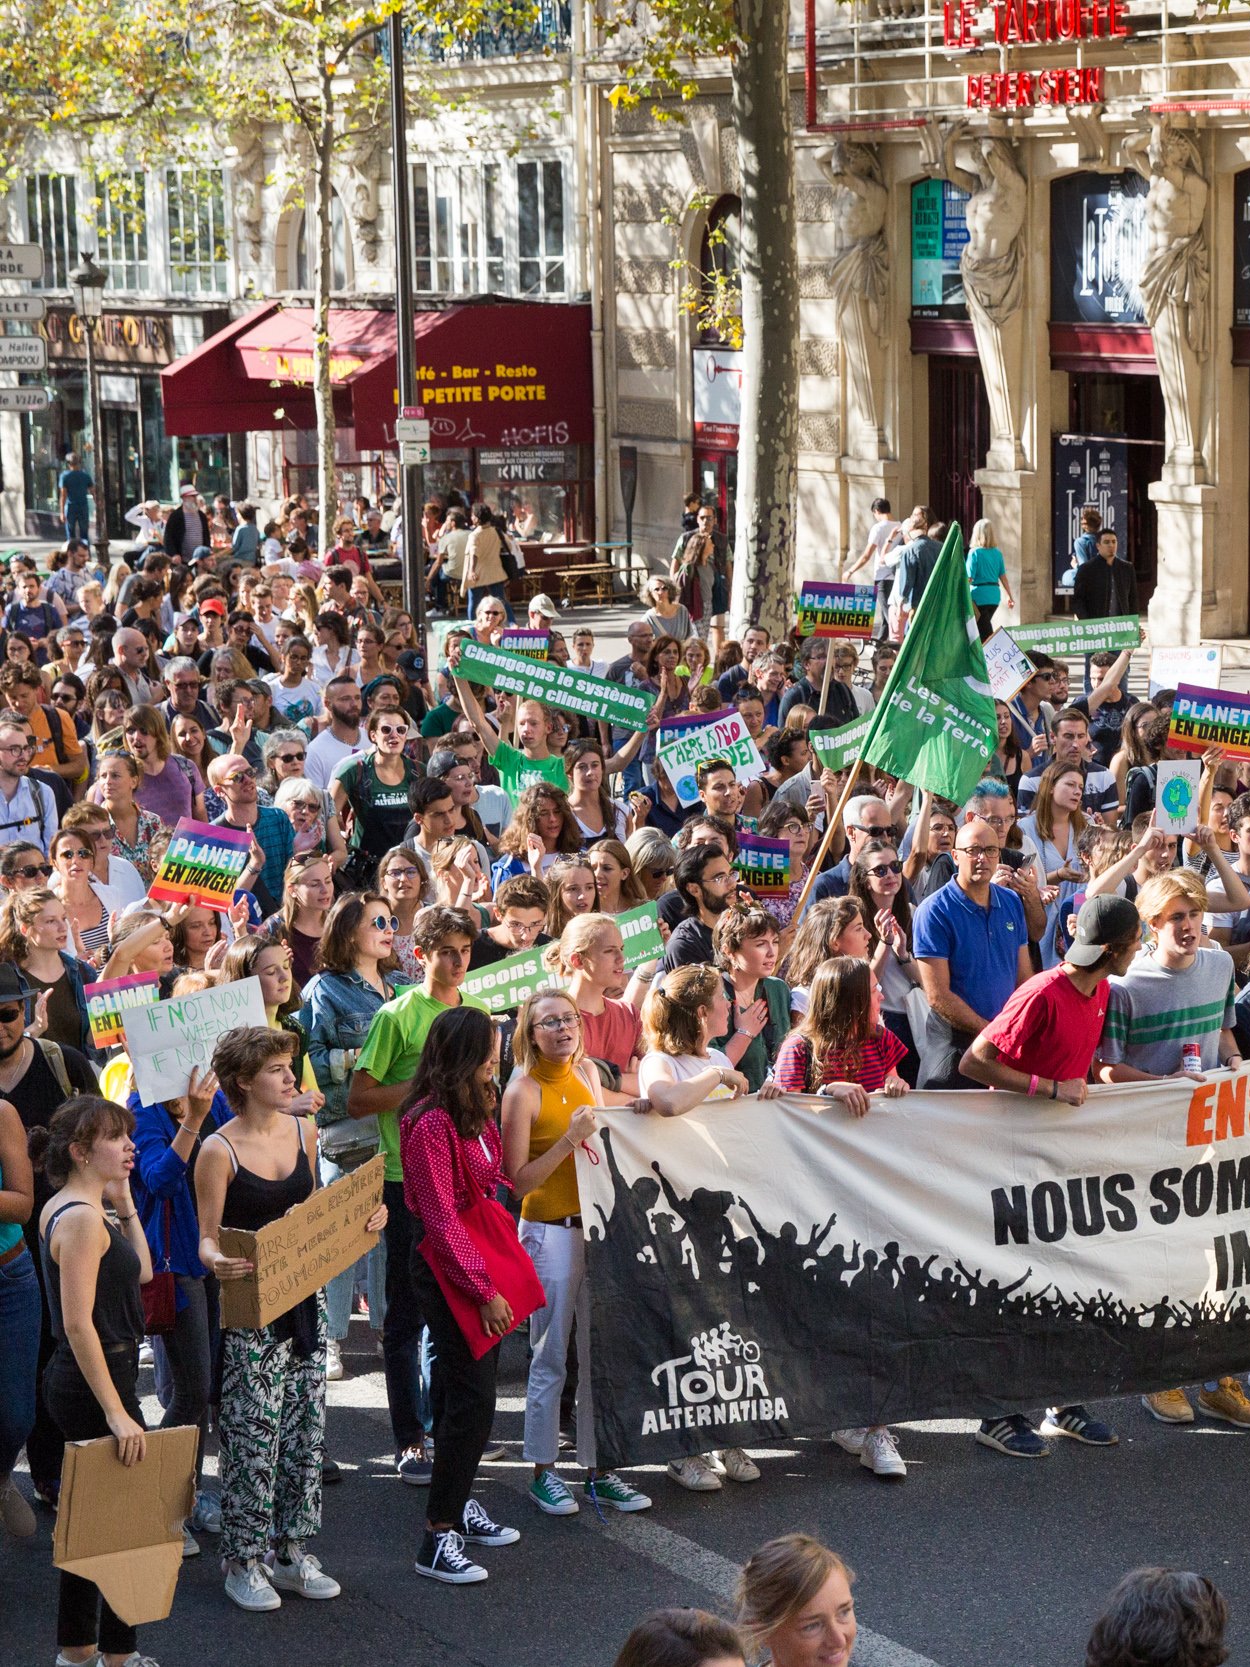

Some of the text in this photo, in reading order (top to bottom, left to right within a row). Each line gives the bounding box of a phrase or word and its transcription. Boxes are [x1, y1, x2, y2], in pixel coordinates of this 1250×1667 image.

[943, 0, 977, 48] LE
[968, 66, 1100, 108] PETER STEIN
[452, 365, 480, 379] Bar
[495, 364, 538, 378] Resto
[422, 386, 483, 404] PETITE
[487, 384, 547, 401] PORTE
[804, 593, 873, 612] PLANETE
[802, 610, 871, 628] EN DANGER
[1072, 624, 1085, 637] le
[1086, 620, 1138, 637] système,
[503, 637, 548, 650] CLIMAT
[1056, 641, 1067, 653] le
[1068, 638, 1106, 652] climat
[464, 645, 648, 713] Changeons le système,
[494, 673, 525, 695] pas
[527, 682, 544, 698] le
[545, 686, 599, 716] climat
[906, 675, 942, 706] Les
[916, 706, 935, 725] la
[942, 716, 989, 758] Terre
[1174, 718, 1196, 737] EN
[658, 737, 707, 769] THERE
[714, 721, 741, 748] NO
[172, 837, 247, 872] PLANETE
[734, 848, 784, 870] NETE
[162, 861, 238, 895] EN DANGER
[741, 868, 784, 886] NGER
[510, 983, 532, 1004] le
[96, 1012, 112, 1033] EN
[146, 1006, 164, 1033] IF
[167, 998, 208, 1028] NOT
[210, 987, 250, 1015] NOW
[152, 1053, 168, 1073] IF
[306, 1205, 325, 1226] DE
[327, 1165, 384, 1213] RESPIRER
[991, 1171, 1138, 1247] NOUS
[651, 1354, 770, 1408] TOUR
[641, 1397, 789, 1436] ALTERNATIBA
